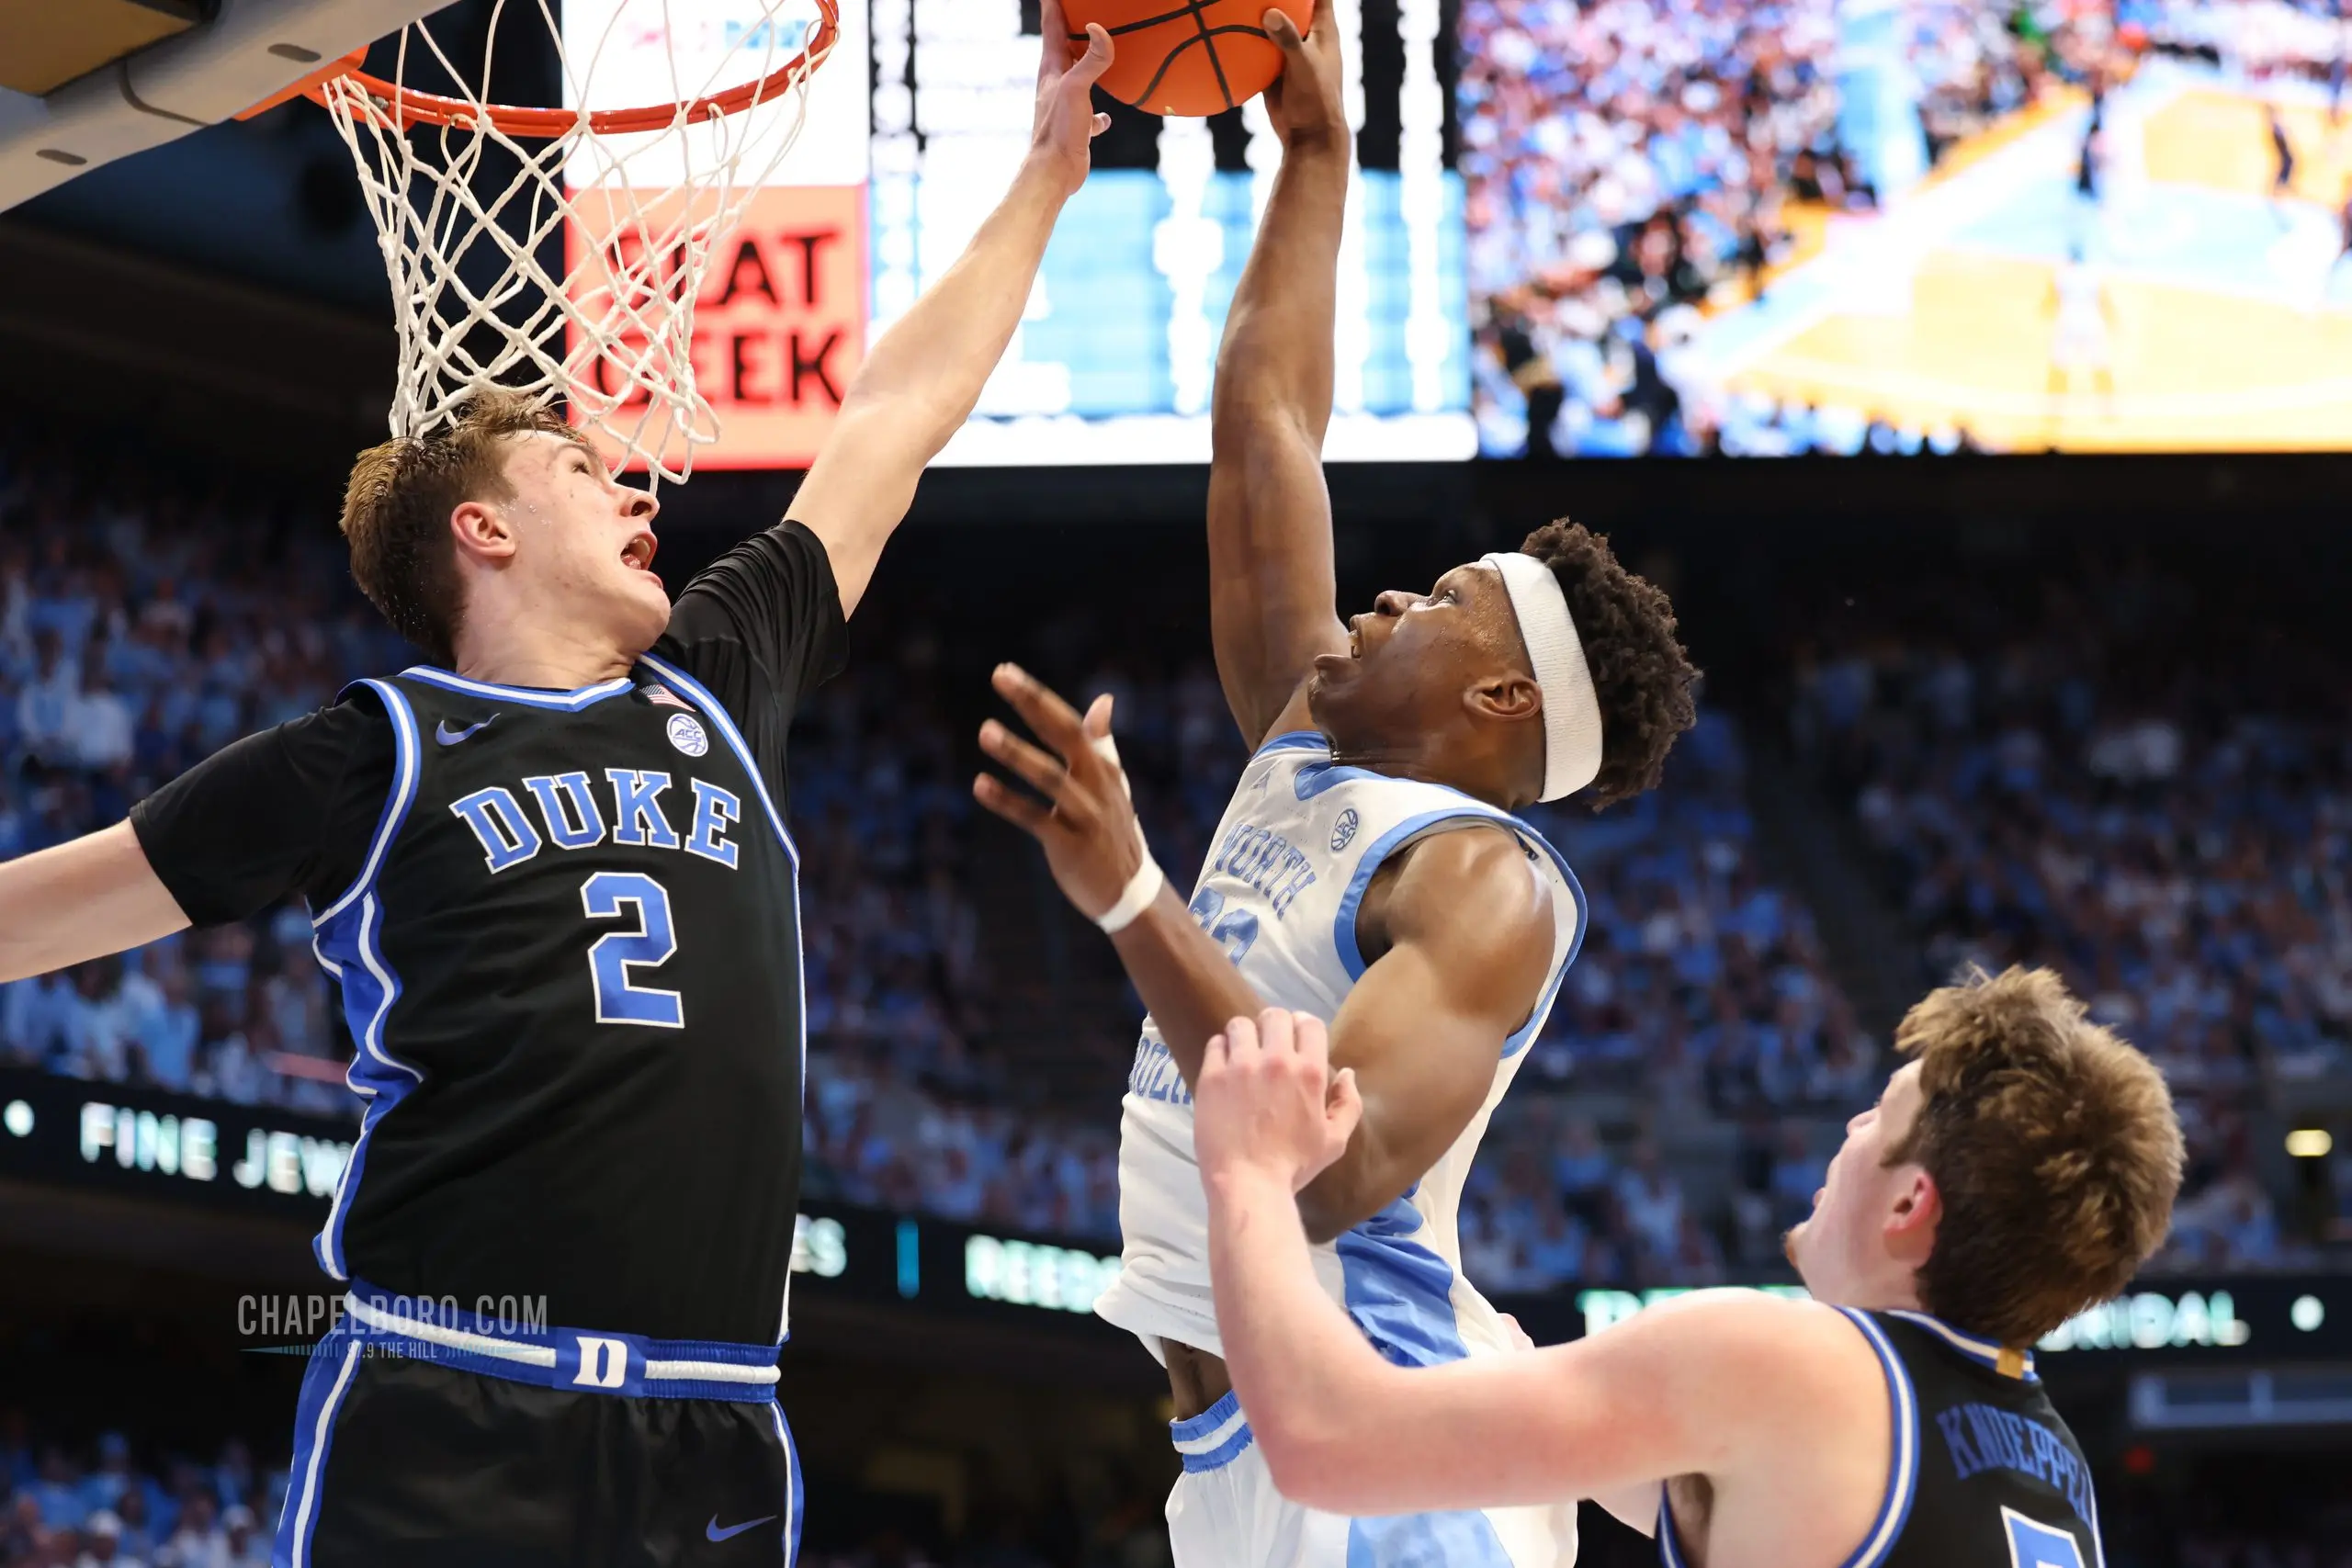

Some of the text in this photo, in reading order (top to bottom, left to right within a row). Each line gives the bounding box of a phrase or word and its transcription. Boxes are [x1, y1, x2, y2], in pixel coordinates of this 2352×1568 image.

[448, 768, 741, 874] DUKE
[1213, 822, 1316, 920] NORTH
[581, 872, 684, 1029] 2
[80, 1101, 218, 1182] FINE
[572, 1336, 628, 1389] D
